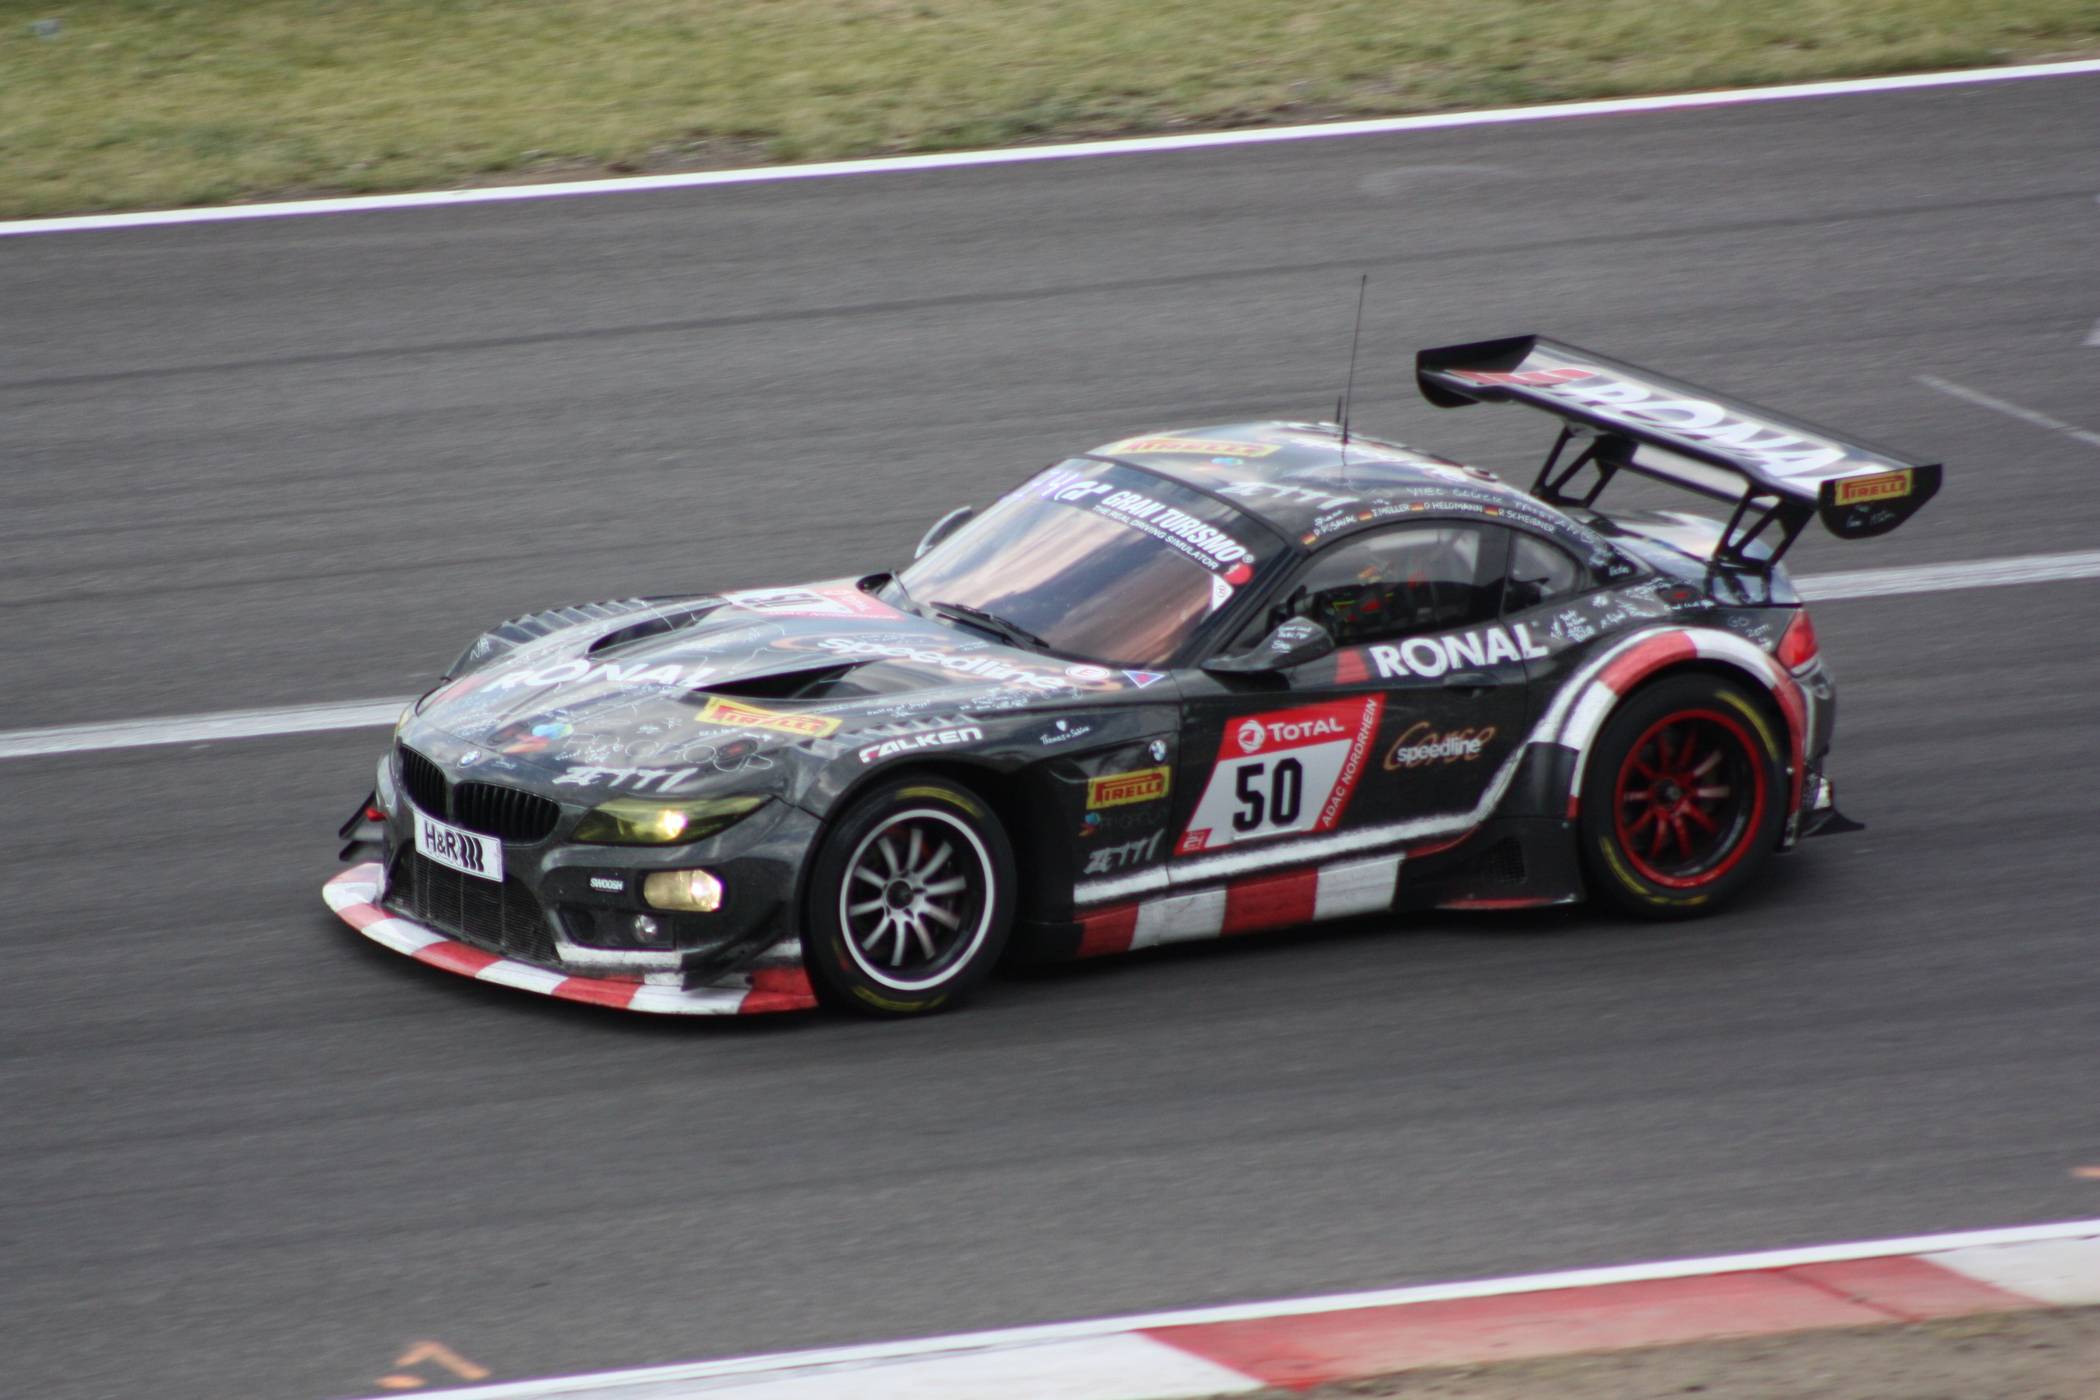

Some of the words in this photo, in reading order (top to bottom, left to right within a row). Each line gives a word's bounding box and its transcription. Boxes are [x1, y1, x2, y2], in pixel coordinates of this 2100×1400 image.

[1841, 473, 1907, 501] PIRELLI
[1101, 491, 1161, 518] GRAN
[1150, 508, 1248, 563] TURISMO
[1130, 518, 1167, 539] DRIVING
[1165, 534, 1219, 570] SIMULATOR
[1368, 623, 1549, 678] RONAL
[859, 726, 984, 764] FALKEN
[1267, 718, 1345, 742] TOTAL
[1397, 736, 1481, 767] speedline
[1321, 785, 1347, 828] ADAC
[1341, 698, 1378, 784] NORDRHEIN
[1093, 771, 1164, 805] PIRELLI
[1231, 756, 1303, 833] 50
[423, 819, 459, 862] H&R
